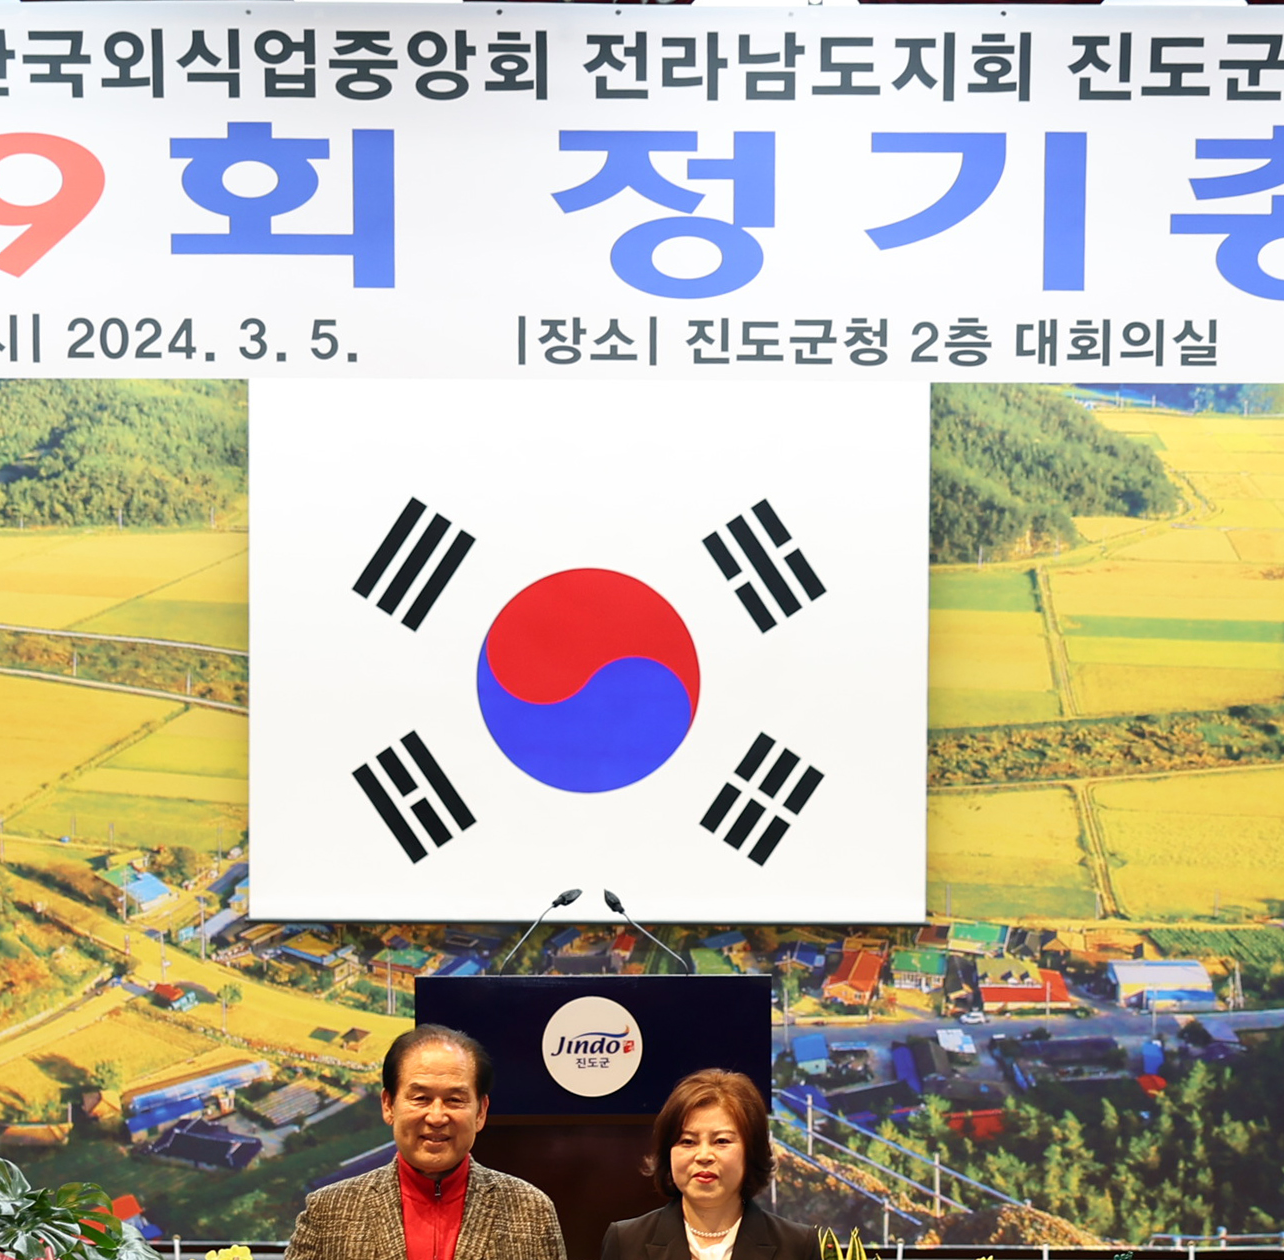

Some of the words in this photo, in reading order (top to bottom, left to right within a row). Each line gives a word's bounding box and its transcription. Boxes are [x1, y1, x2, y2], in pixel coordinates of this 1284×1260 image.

[583, 30, 1032, 102] 전라남도지회
[66, 318, 217, 362] 2024.
[238, 318, 287, 362] 3.
[309, 318, 360, 362] 5.
[685, 318, 889, 366] 진도군청
[909, 318, 992, 366] 2층
[1015, 318, 1219, 366] 대회의실
[551, 1036, 620, 1057] Jindo
[576, 1057, 610, 1068] 진도군
